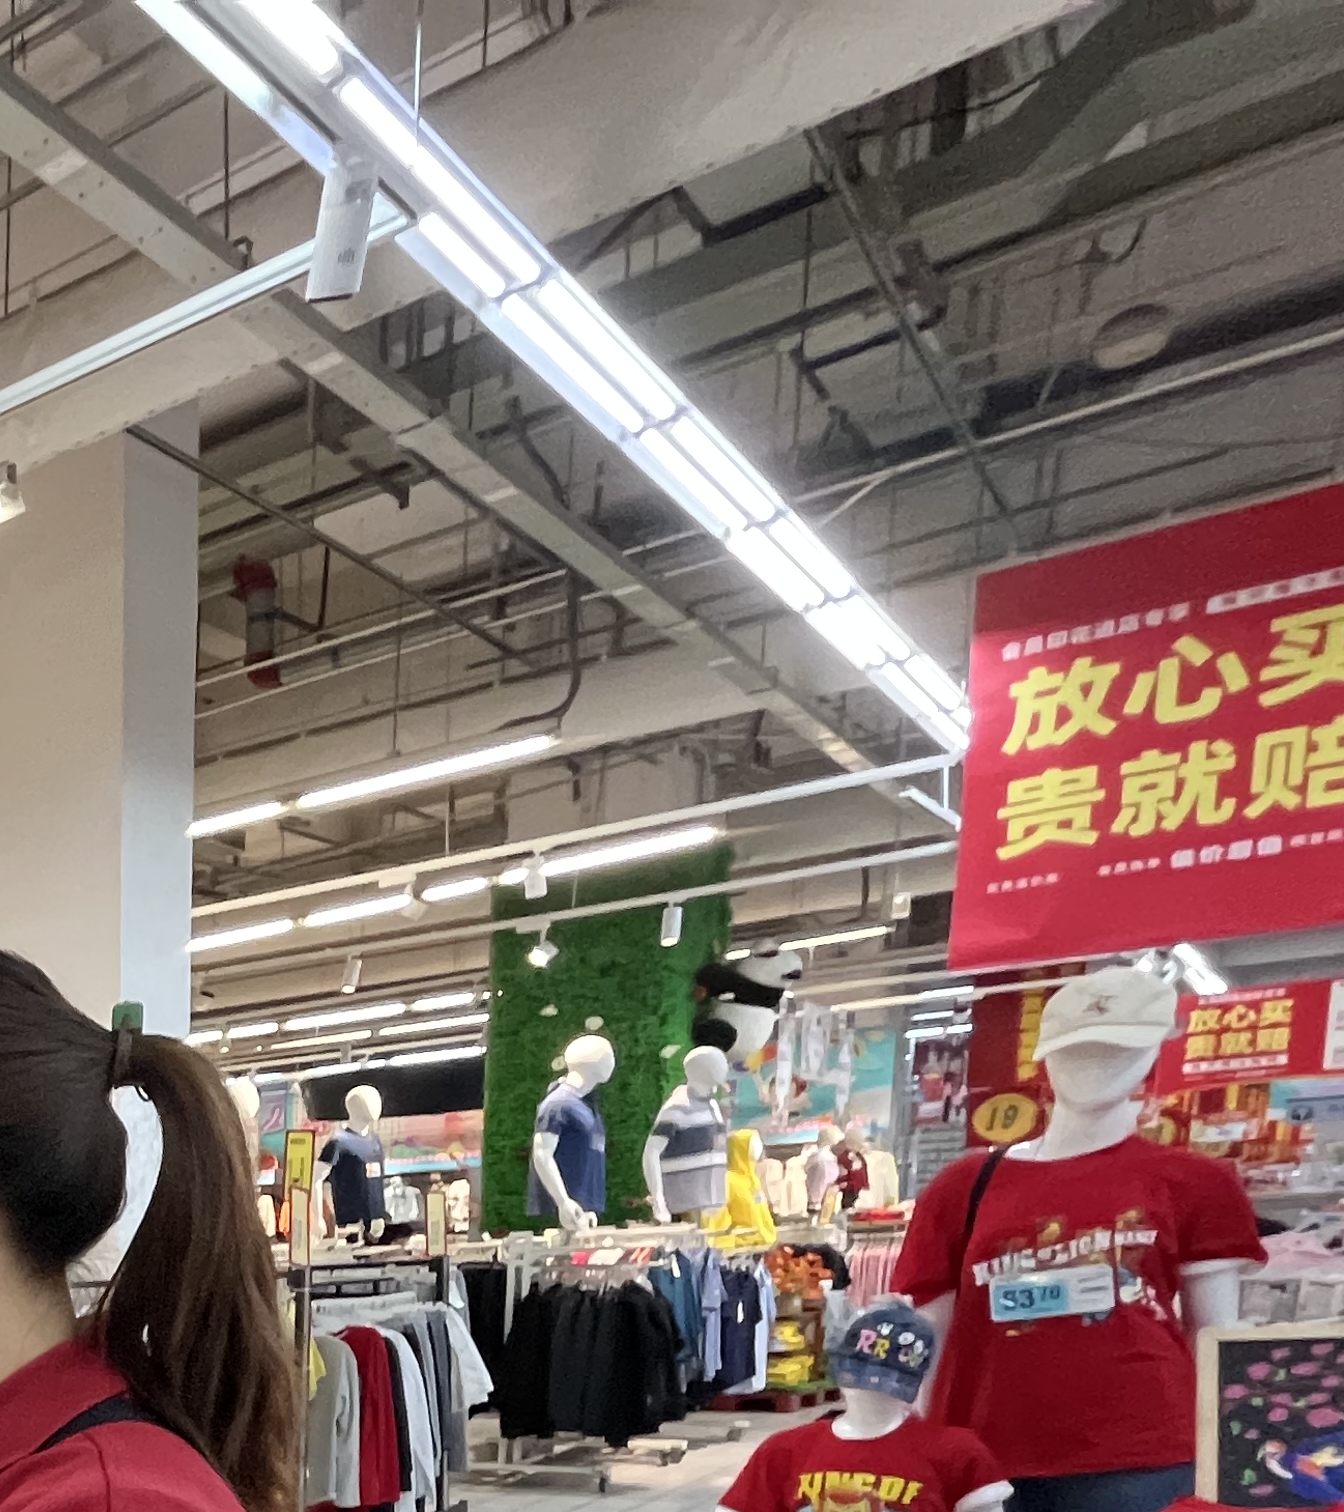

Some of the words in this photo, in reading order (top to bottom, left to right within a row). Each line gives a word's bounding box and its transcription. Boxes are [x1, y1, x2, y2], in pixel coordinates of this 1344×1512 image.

[1001, 603, 1344, 757] 放心买
[996, 713, 1344, 861] 贵就赔
